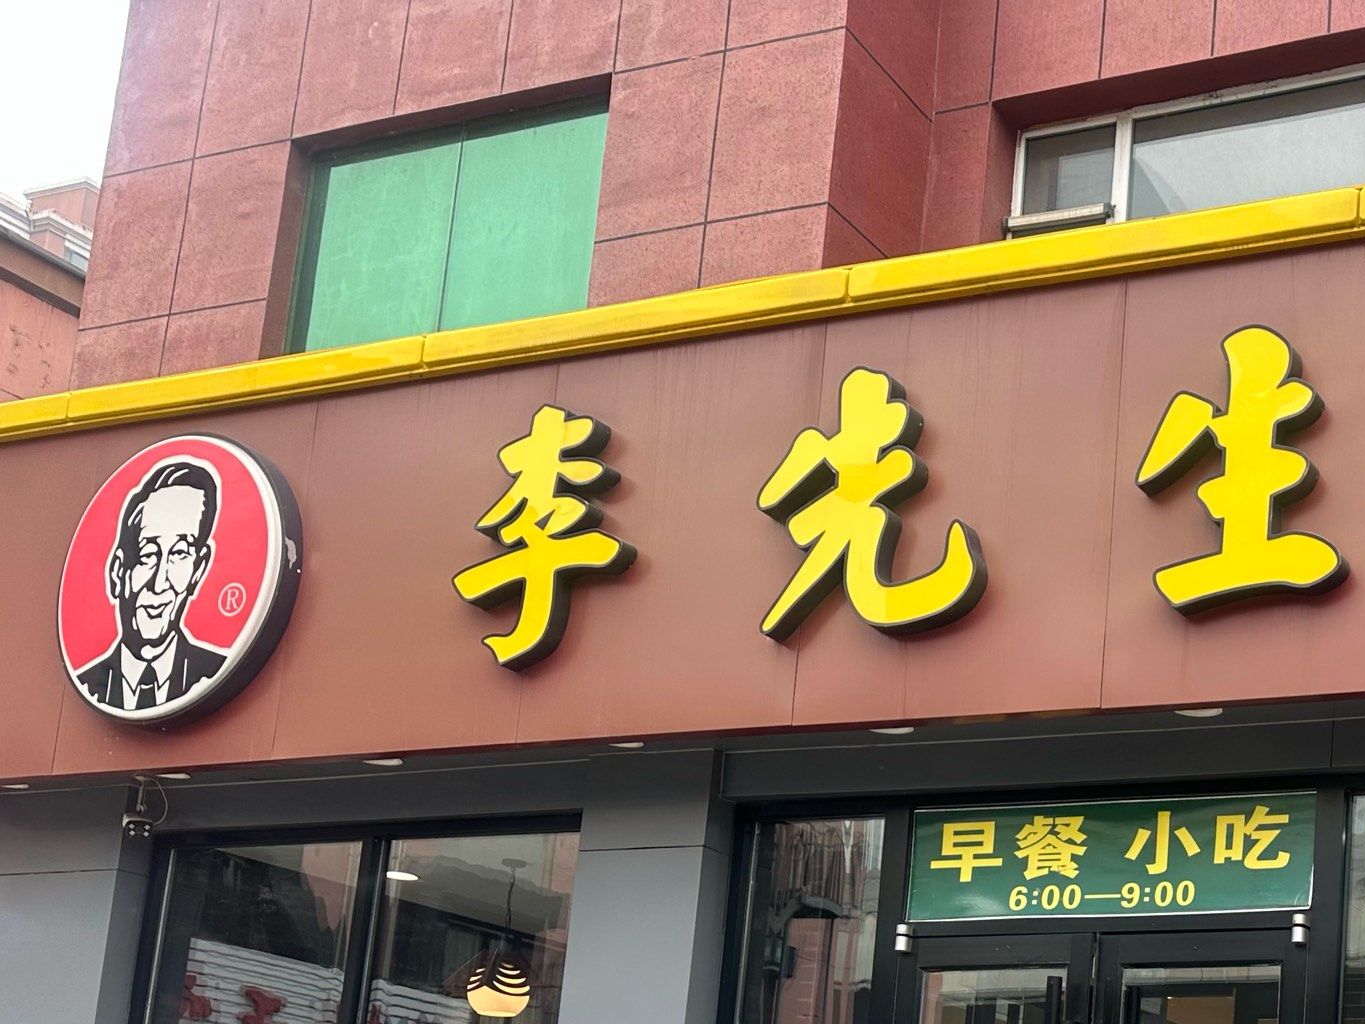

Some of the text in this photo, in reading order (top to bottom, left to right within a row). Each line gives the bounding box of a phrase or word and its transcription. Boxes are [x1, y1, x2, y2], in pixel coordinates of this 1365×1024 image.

[452, 324, 1345, 670] 李先生
[930, 805, 1290, 882] 早餐 小吃
